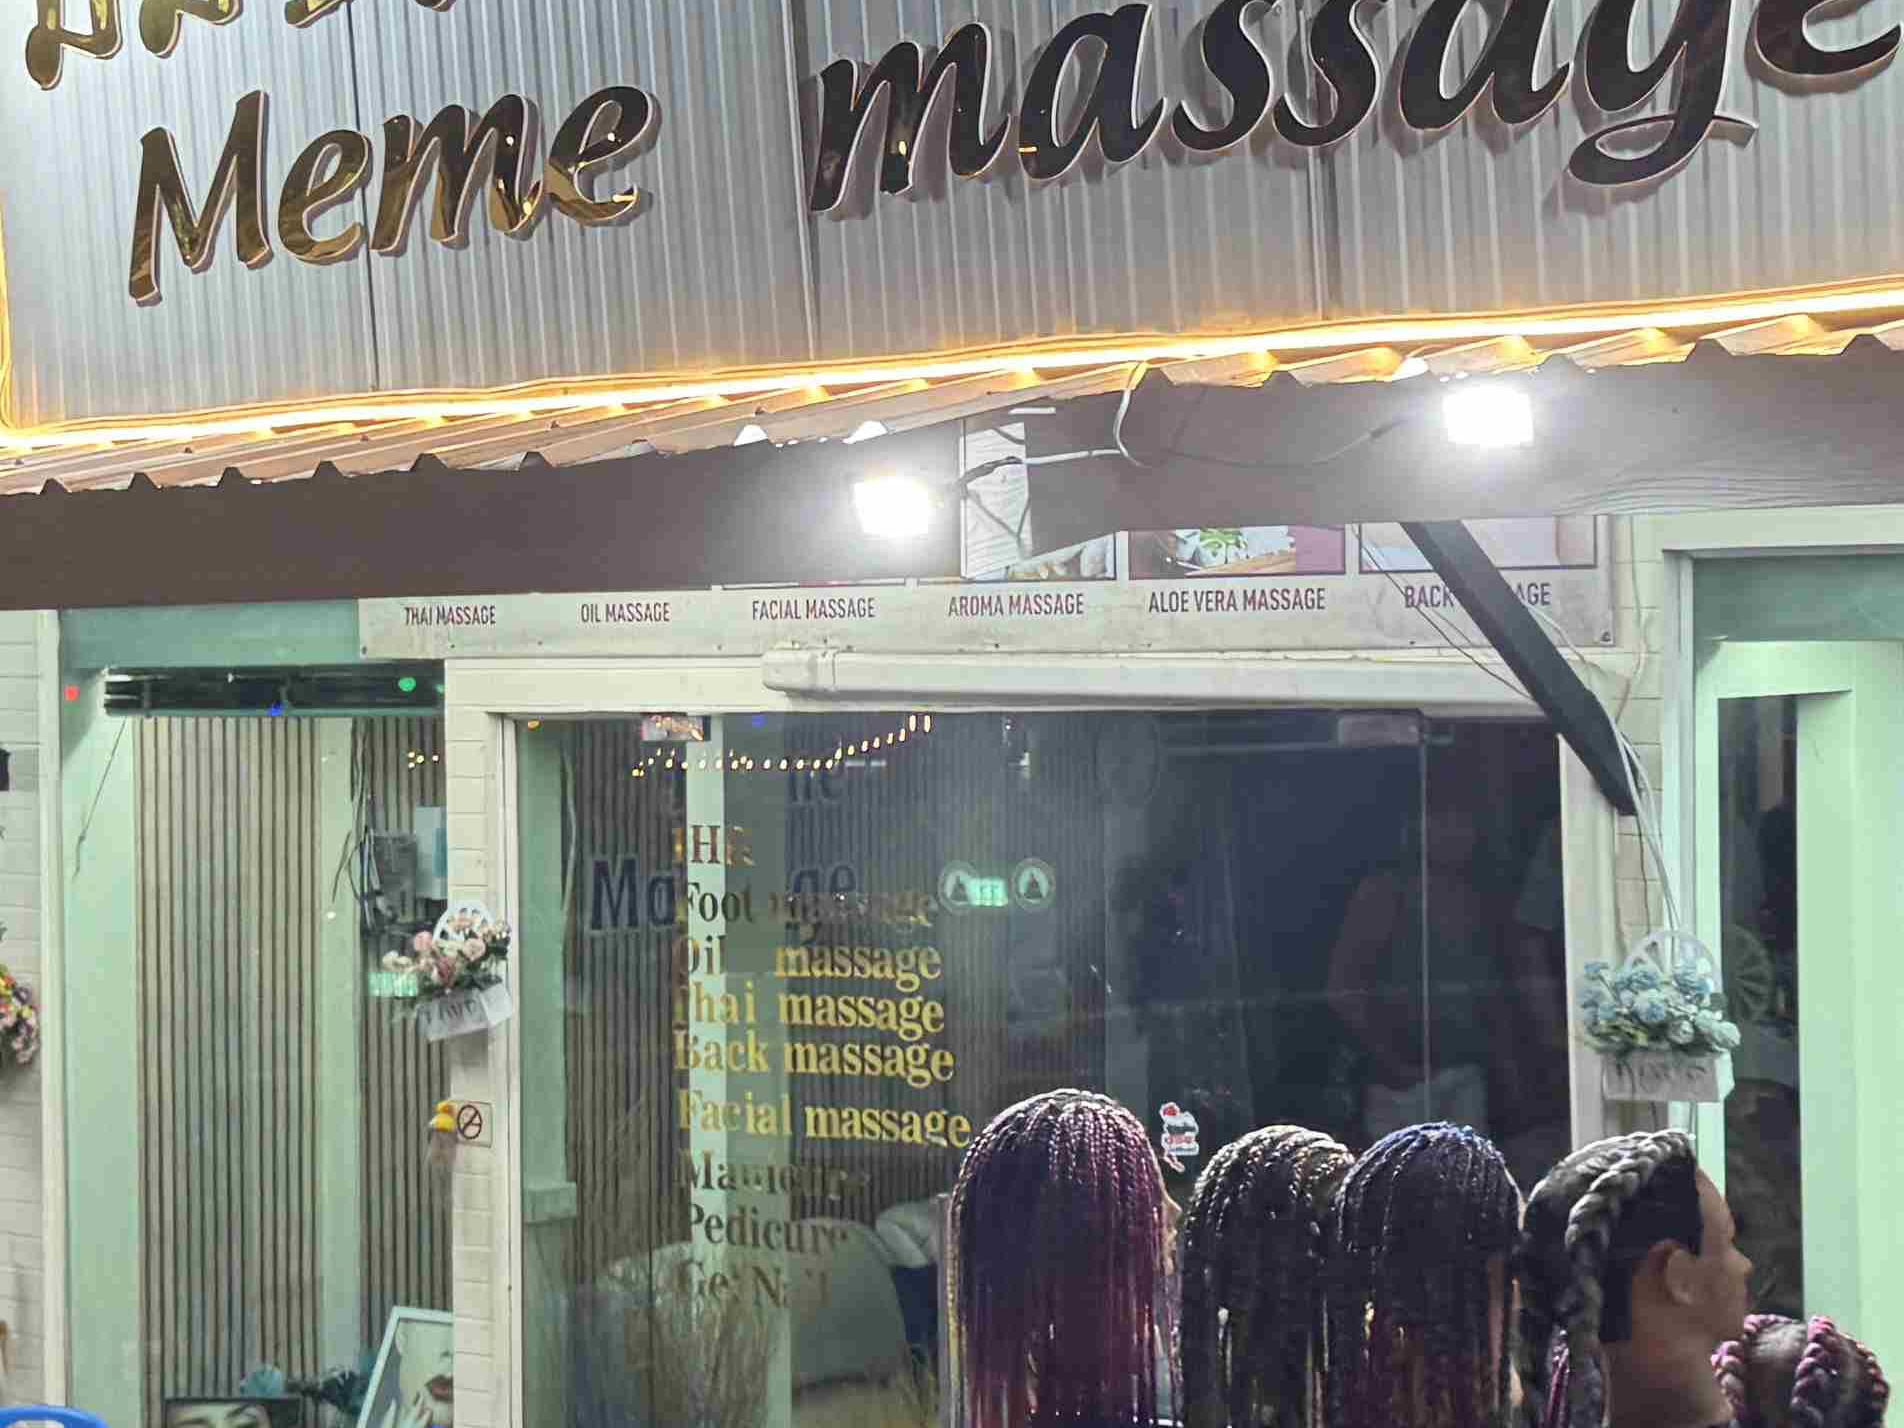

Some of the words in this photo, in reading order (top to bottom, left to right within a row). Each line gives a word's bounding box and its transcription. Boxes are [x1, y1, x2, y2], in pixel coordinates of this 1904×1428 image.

[126, 80, 658, 307] Meme
[404, 606, 434, 626] THAI
[436, 603, 496, 626] MASSAGE
[580, 604, 601, 624] OIL
[605, 602, 671, 623] MASSAGE
[752, 599, 802, 621] FACIAL
[805, 597, 876, 620] MASSAGE
[947, 595, 1004, 617] AROMA
[1007, 592, 1085, 616] MASSAGE
[1148, 590, 1189, 613] ALOE
[1194, 589, 1238, 612] VERA
[1241, 587, 1326, 611] MASSAGE
[775, 944, 943, 993] massage
[673, 979, 757, 1027] Thai
[777, 992, 945, 1042] massage
[673, 1025, 770, 1073] Back
[783, 1041, 956, 1089] massage
[677, 1089, 792, 1138] Facial
[804, 1103, 973, 1149] massage
